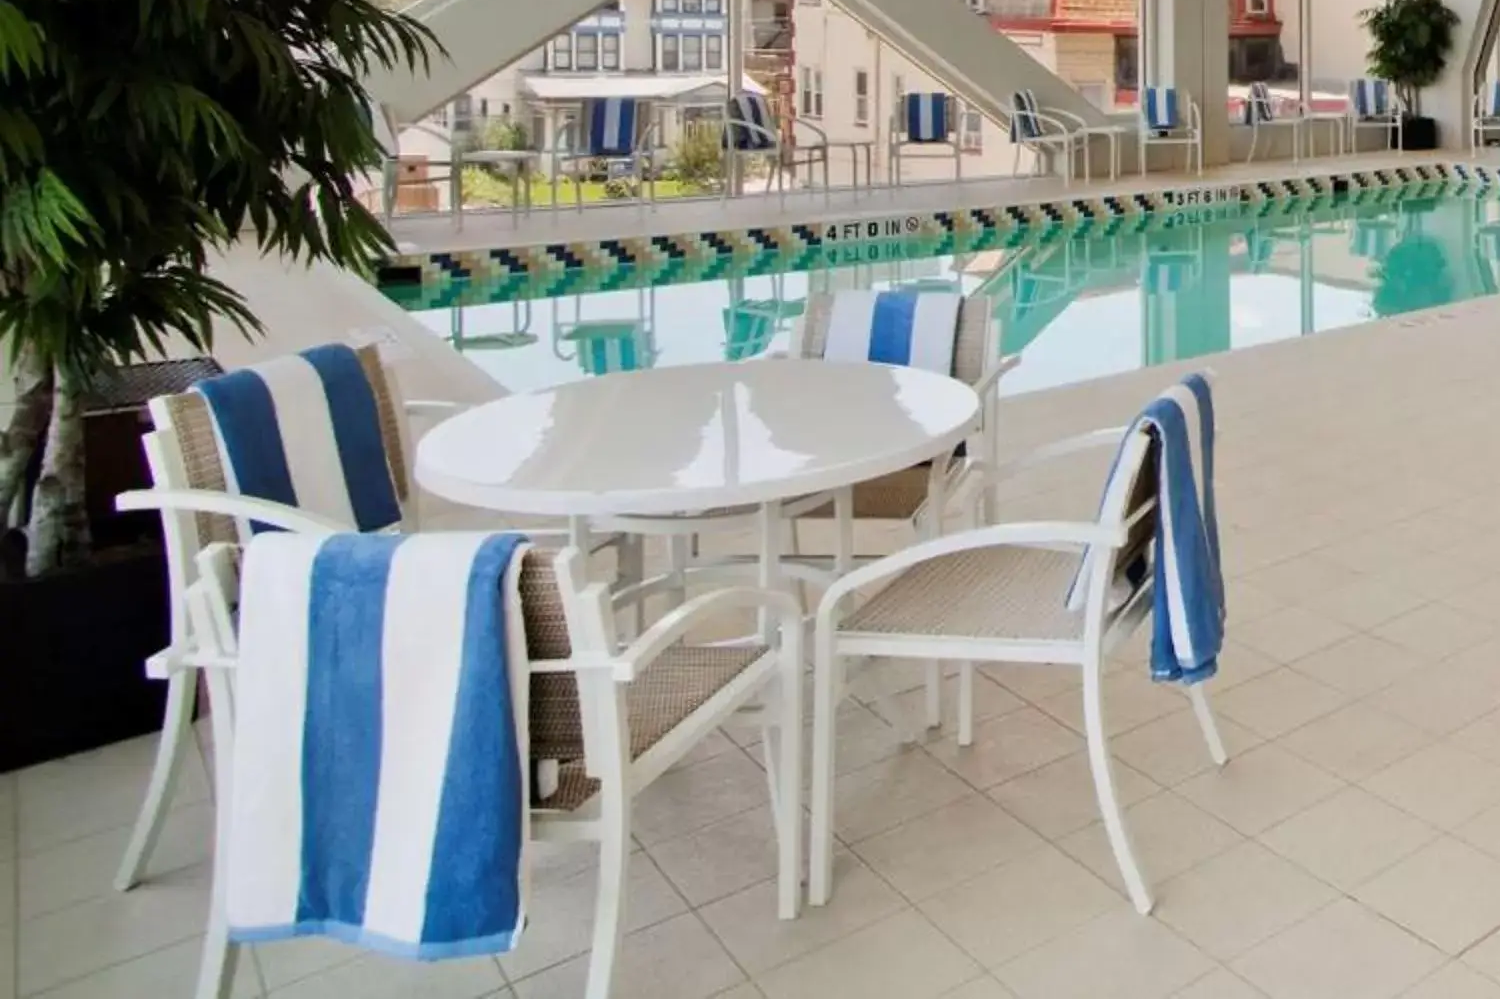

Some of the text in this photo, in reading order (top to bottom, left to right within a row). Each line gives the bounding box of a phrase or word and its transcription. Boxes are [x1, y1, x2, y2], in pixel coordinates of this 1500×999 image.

[1187, 190, 1200, 205] FT
[826, 219, 901, 241] 4 FT 0 IN
